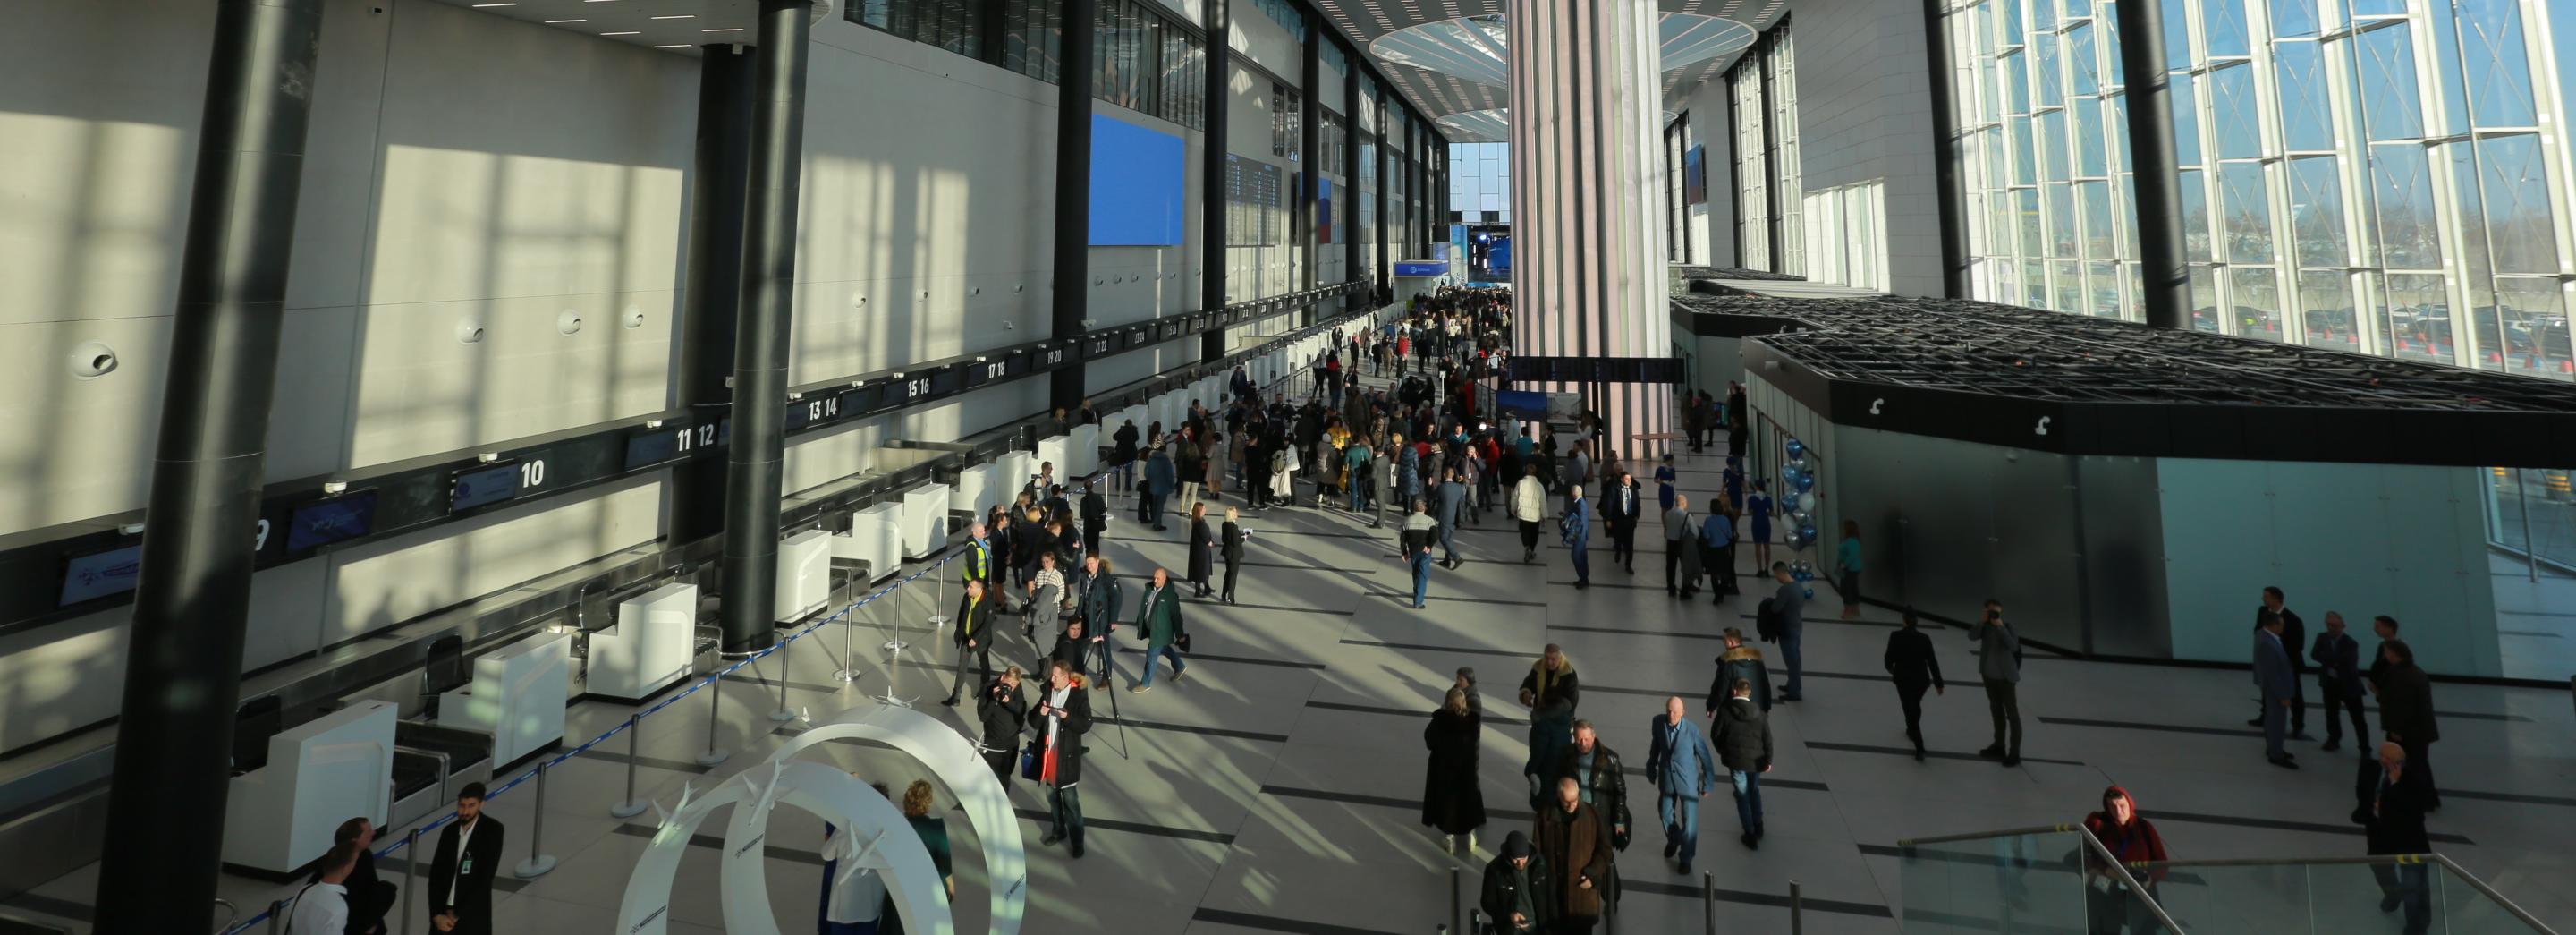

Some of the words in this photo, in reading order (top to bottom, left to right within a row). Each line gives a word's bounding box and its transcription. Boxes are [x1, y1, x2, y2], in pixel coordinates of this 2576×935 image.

[1055, 349, 1062, 363] 20
[988, 364, 996, 378] 17
[997, 361, 1004, 377] 18
[909, 380, 917, 397] 15
[920, 378, 929, 395] 16
[809, 401, 820, 421] 13
[825, 398, 836, 417] 14
[677, 428, 691, 452] 11
[699, 423, 714, 446] 12
[521, 459, 545, 488] 10
[255, 519, 270, 551] 9
